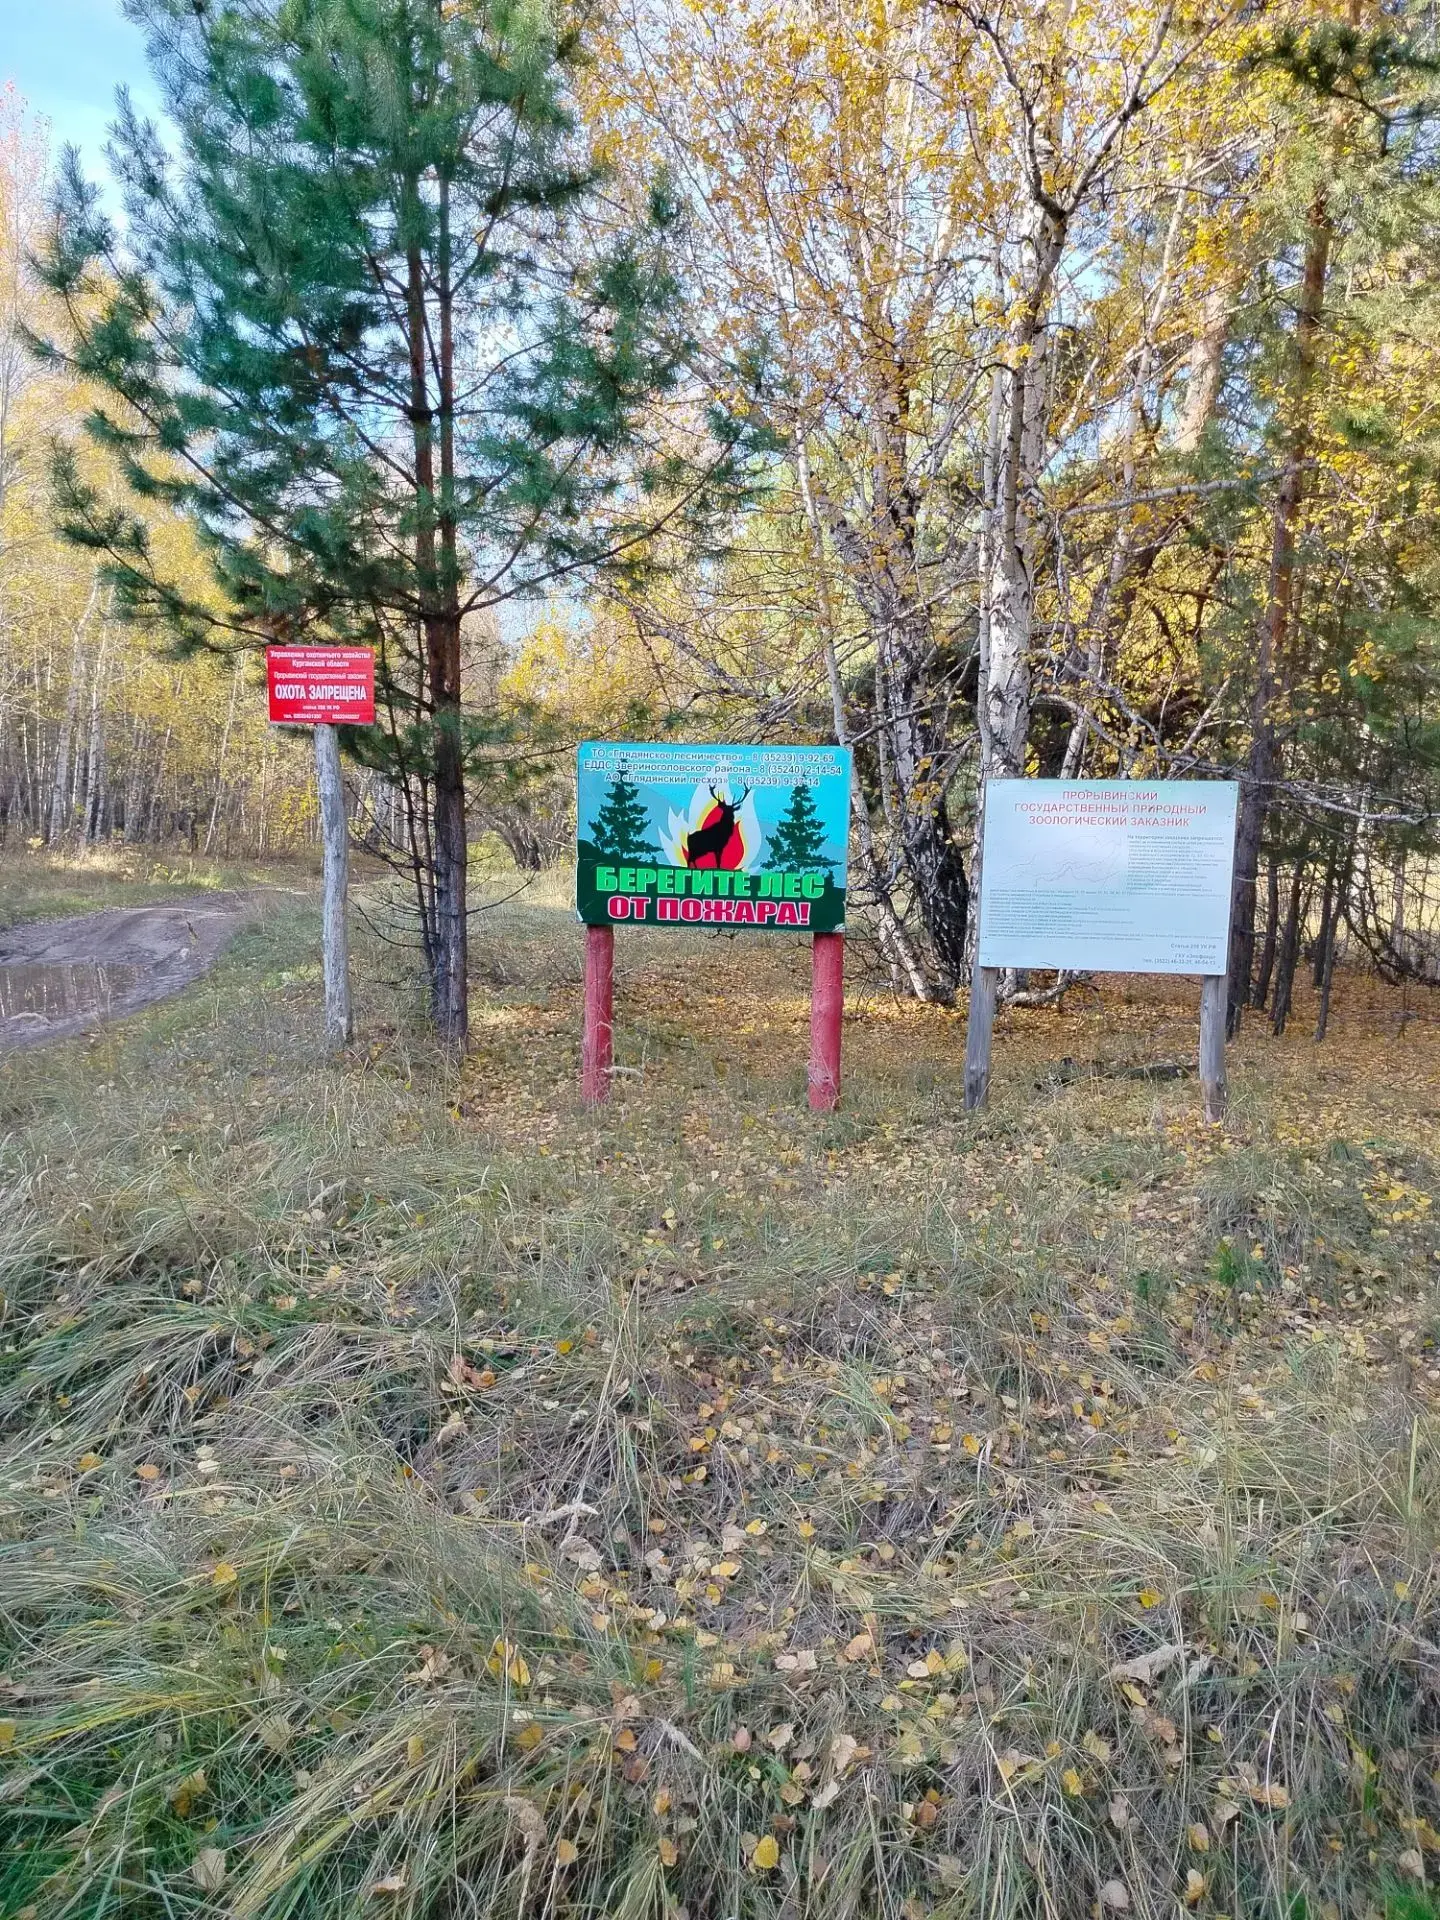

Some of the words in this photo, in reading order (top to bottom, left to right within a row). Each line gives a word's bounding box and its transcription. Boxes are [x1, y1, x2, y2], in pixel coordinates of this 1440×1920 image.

[292, 660, 325, 668] Курганской
[275, 684, 306, 699] ОХОТА
[309, 685, 366, 702] ЗАПРЕЩЕНА
[592, 749, 605, 757] ТО
[674, 753, 742, 761] лесничество»
[761, 753, 796, 763] (35239)
[584, 761, 611, 770] ЕДДС
[615, 761, 711, 772] Звериноголовского
[714, 765, 751, 775] района
[760, 765, 765, 773] 8
[768, 765, 803, 775] (35240)
[806, 766, 841, 775] 2-14-54
[605, 772, 620, 781] АО
[690, 776, 728, 785] лесхоз»
[737, 776, 743, 784] 8
[746, 776, 780, 786] (35239)
[1062, 790, 1158, 801] ПРОРЫВИНСКИЙ
[1014, 802, 1129, 813] ГОСУДАРСТВЕННЫЙ
[1133, 804, 1207, 815] ПРИРОДНЫЙ
[1029, 814, 1127, 825] ЗООЛОГИЧЕСКИЙ
[1131, 817, 1190, 827] ЗАКАЗНИК
[596, 866, 751, 897] БЕРЕГИТЕ
[758, 873, 825, 899] ЛЕС
[607, 896, 651, 919] ОТ
[657, 897, 811, 925] ПОЖАРА!
